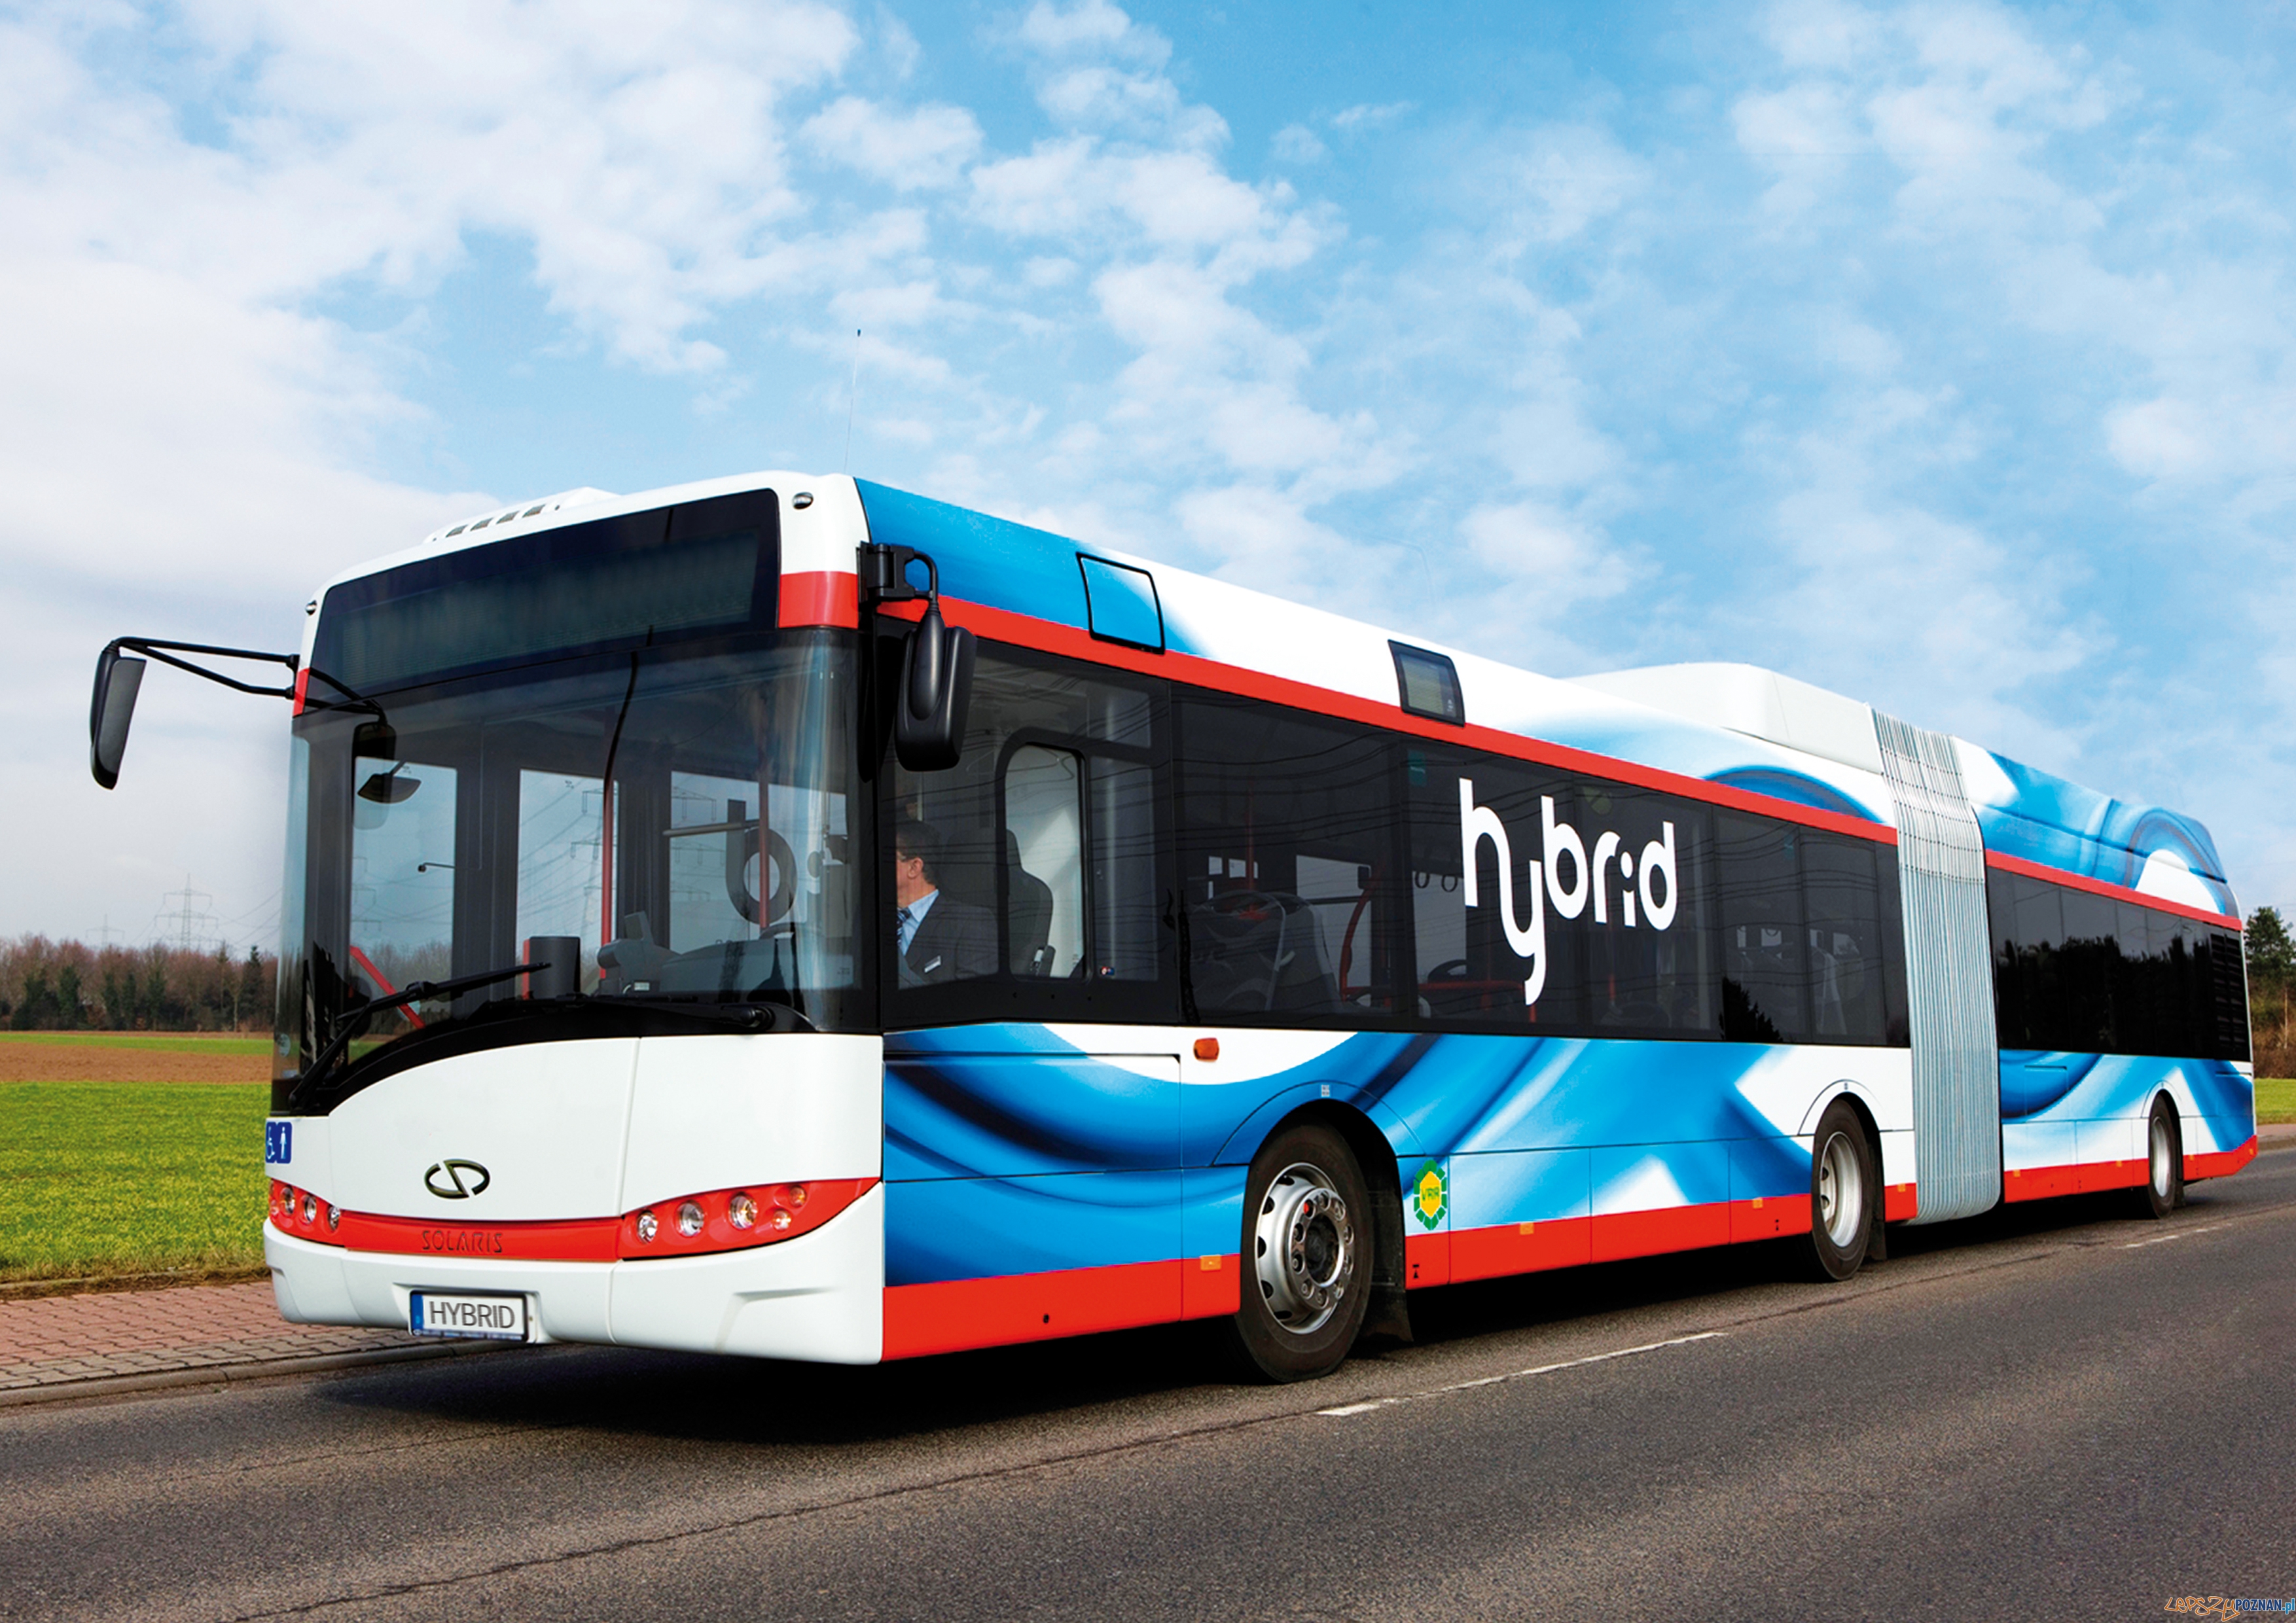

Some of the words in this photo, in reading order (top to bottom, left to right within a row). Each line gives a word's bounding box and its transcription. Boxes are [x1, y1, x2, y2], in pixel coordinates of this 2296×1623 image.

[1459, 777, 1678, 1006] hybrid
[422, 1230, 503, 1253] SOLARIS
[429, 1301, 516, 1329] HYBRID
